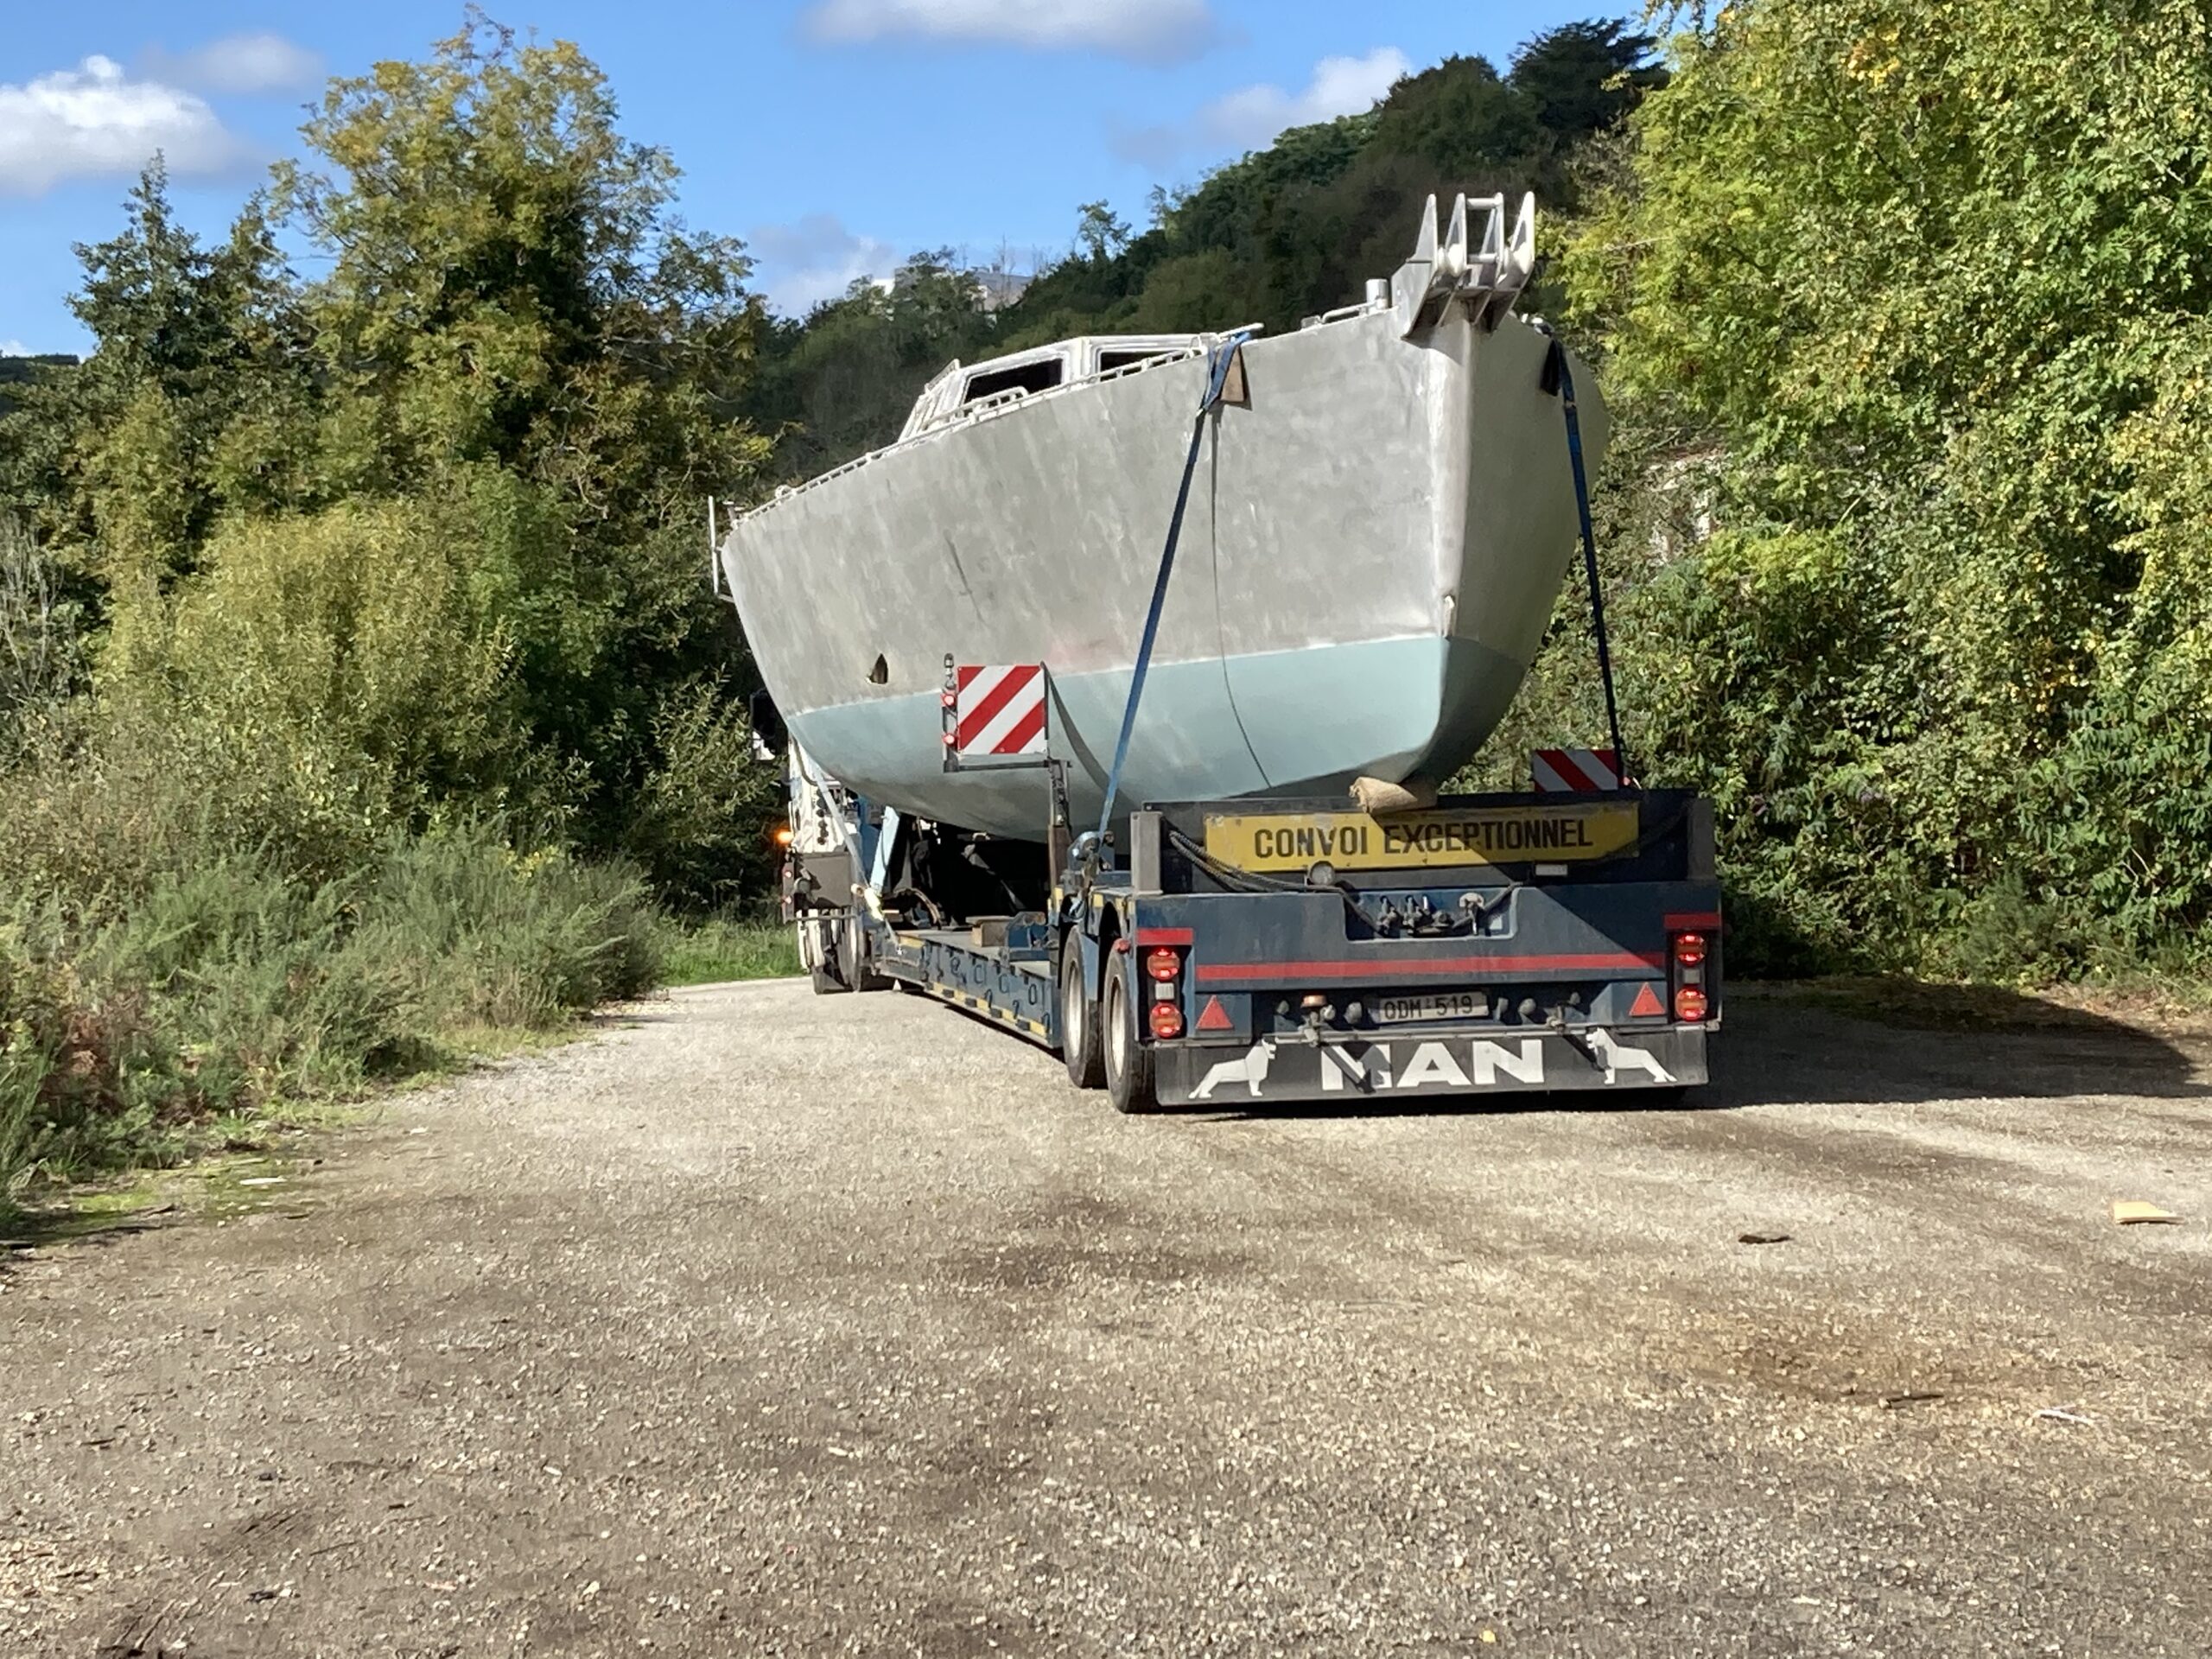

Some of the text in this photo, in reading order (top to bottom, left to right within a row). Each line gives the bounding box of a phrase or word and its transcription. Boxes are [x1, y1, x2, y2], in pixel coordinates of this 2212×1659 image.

[1254, 819, 1593, 859] CONVOI EXCEPTIONNEL
[1321, 1039, 1544, 1090] MAN
